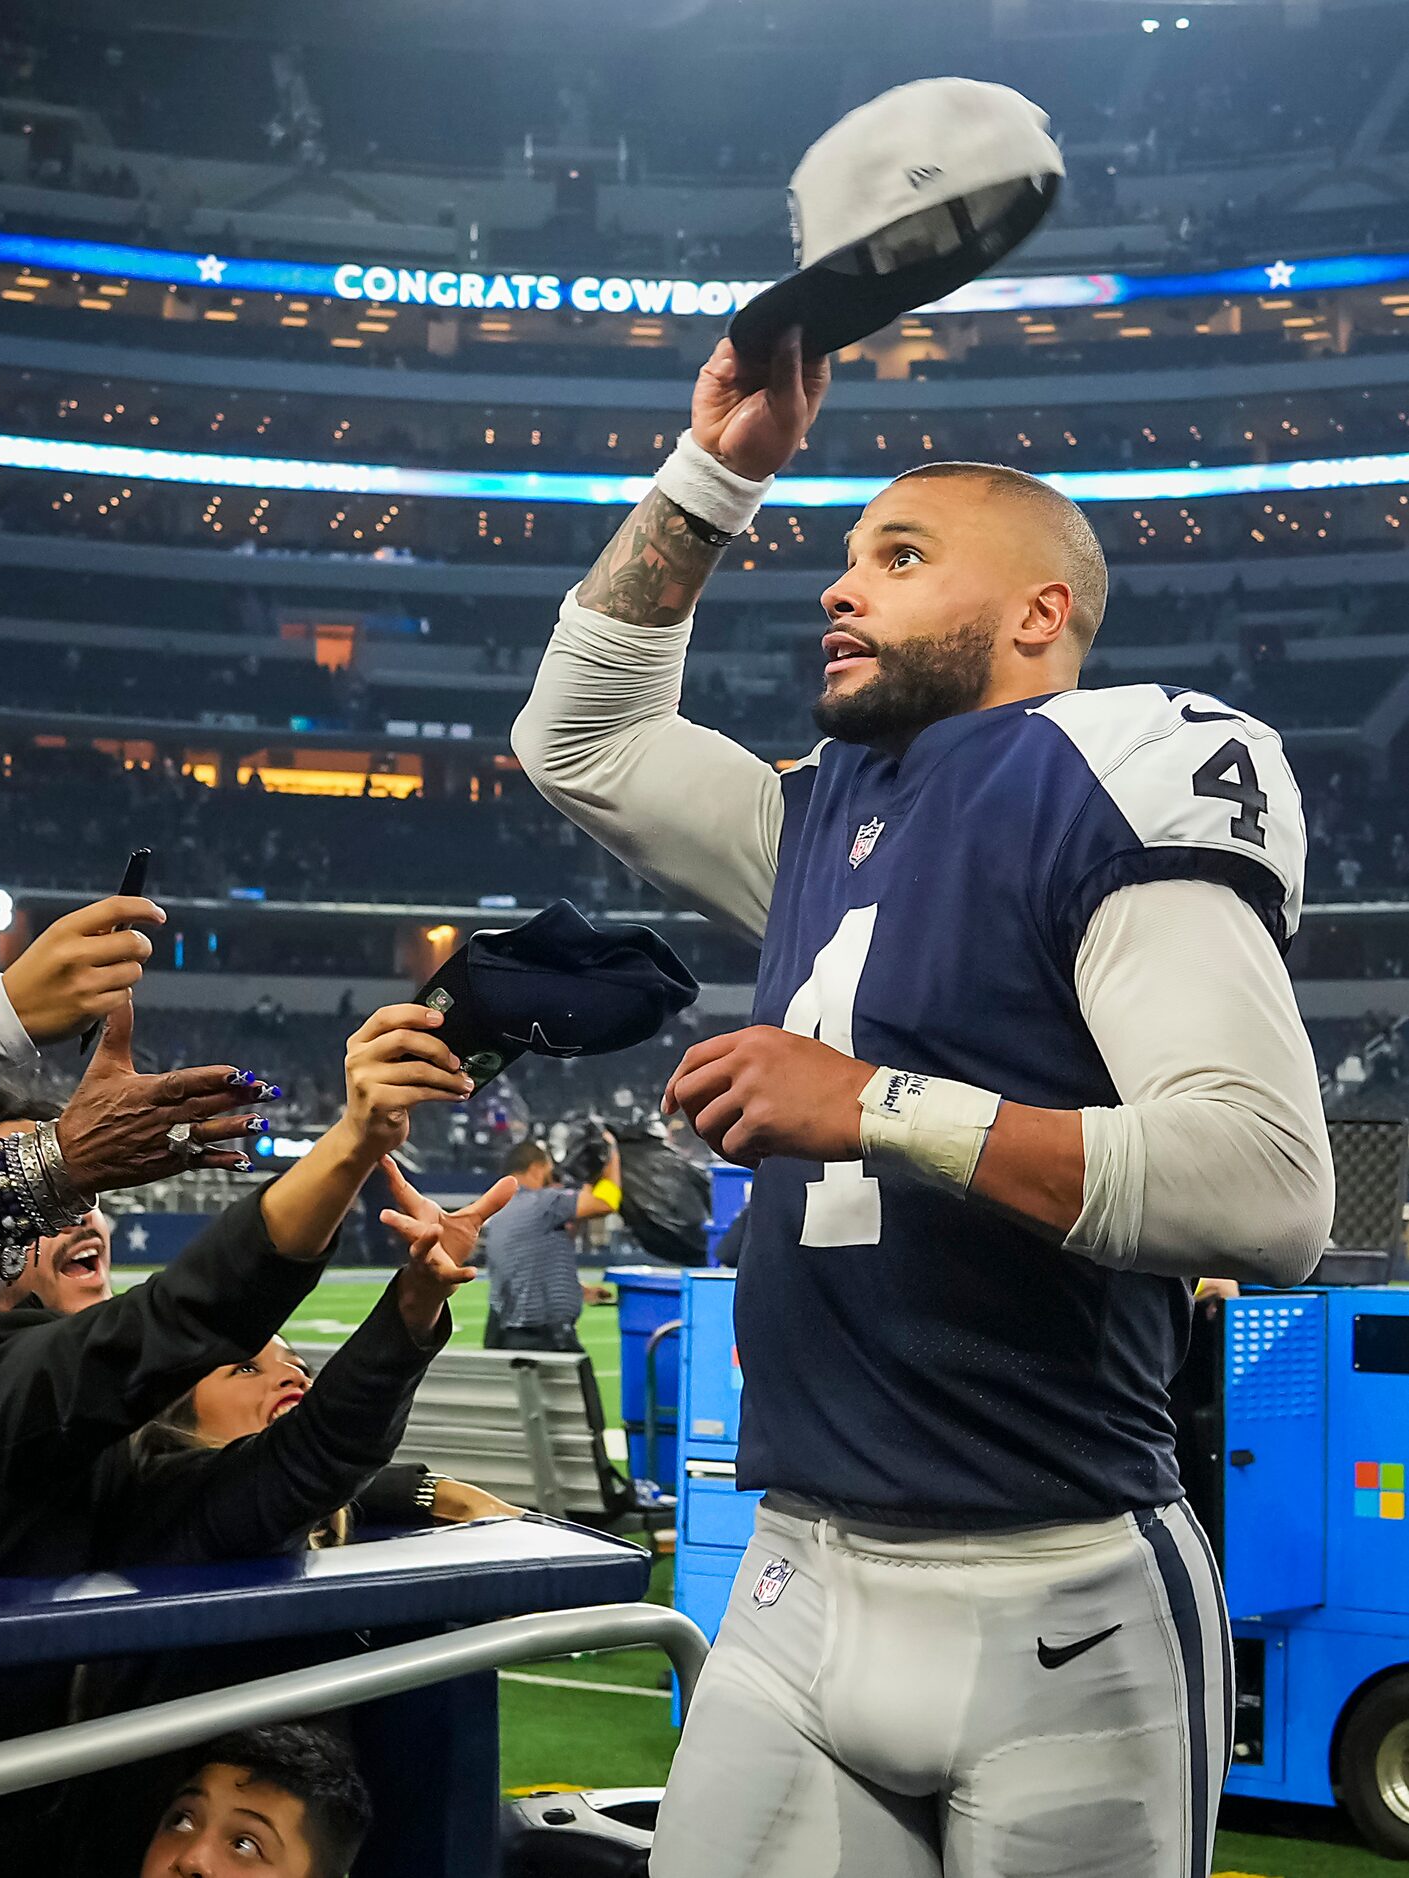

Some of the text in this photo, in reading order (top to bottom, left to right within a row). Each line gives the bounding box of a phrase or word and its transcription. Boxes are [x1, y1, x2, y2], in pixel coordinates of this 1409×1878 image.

[334, 264, 778, 315] CONGRATS COWBOY
[1192, 737, 1269, 850] 4
